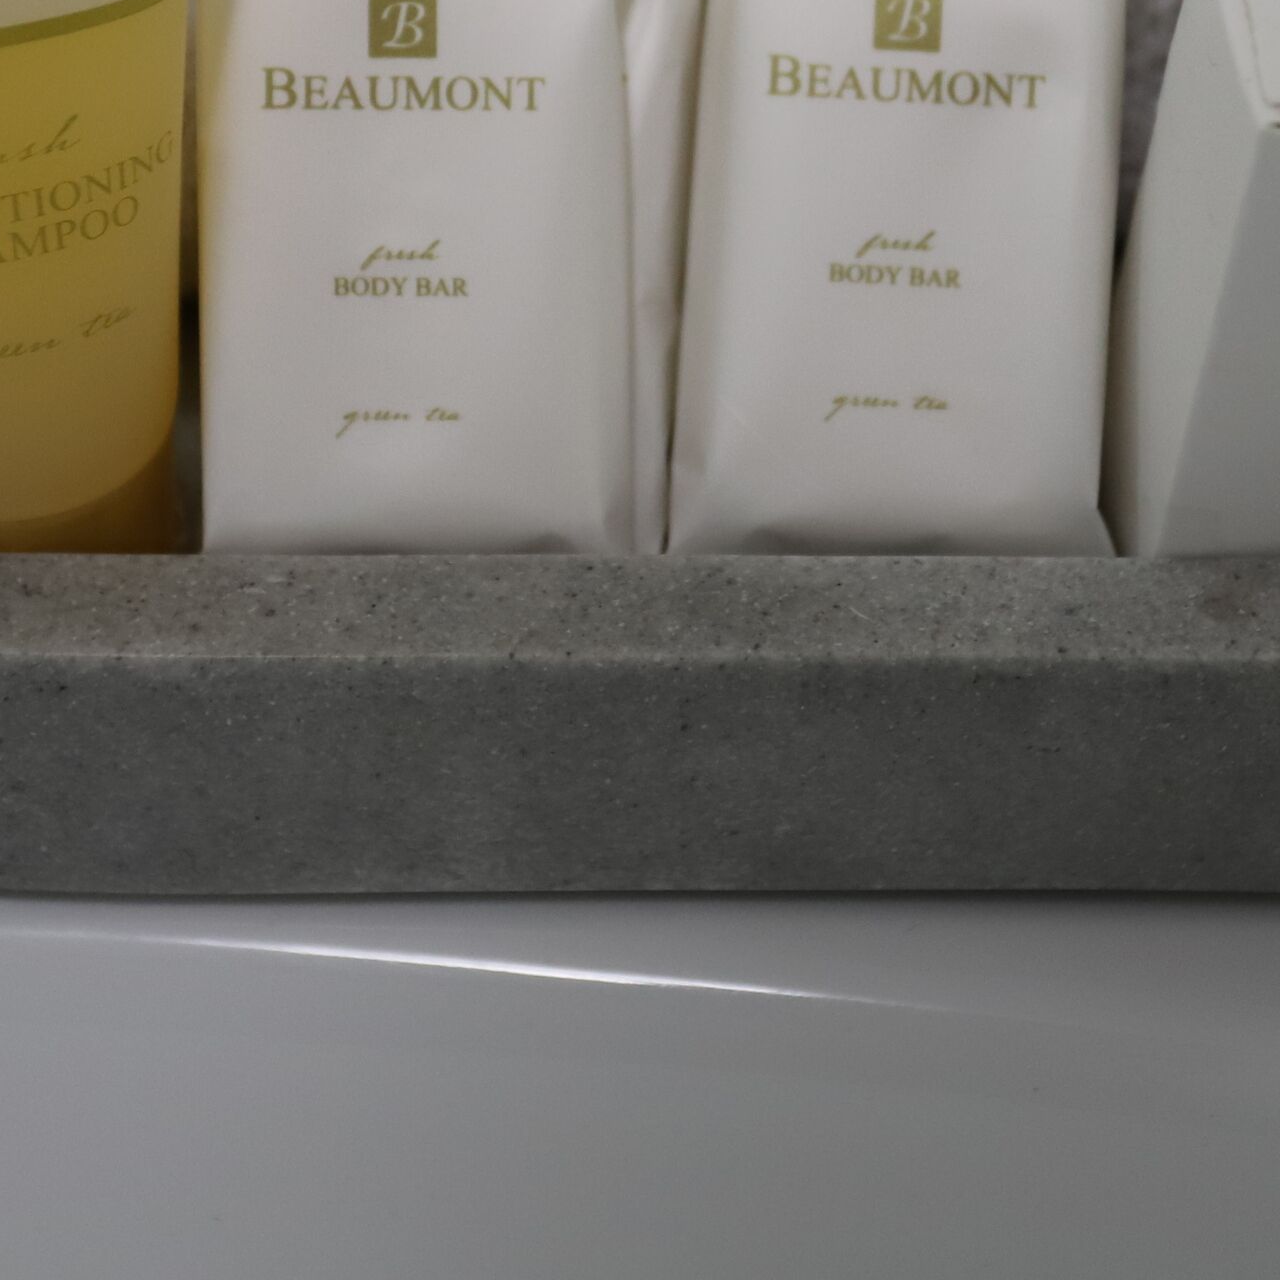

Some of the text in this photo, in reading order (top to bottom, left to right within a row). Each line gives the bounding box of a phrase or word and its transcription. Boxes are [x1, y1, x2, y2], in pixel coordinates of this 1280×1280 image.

[260, 66, 547, 113] BEAUMONT
[766, 53, 1048, 109] BEAUMONT
[360, 239, 441, 271] fresh
[855, 230, 936, 259] fresh
[333, 276, 469, 298] BODY BAR
[829, 261, 962, 289] BODY BAR
[824, 391, 899, 421] green
[335, 409, 411, 440] green
